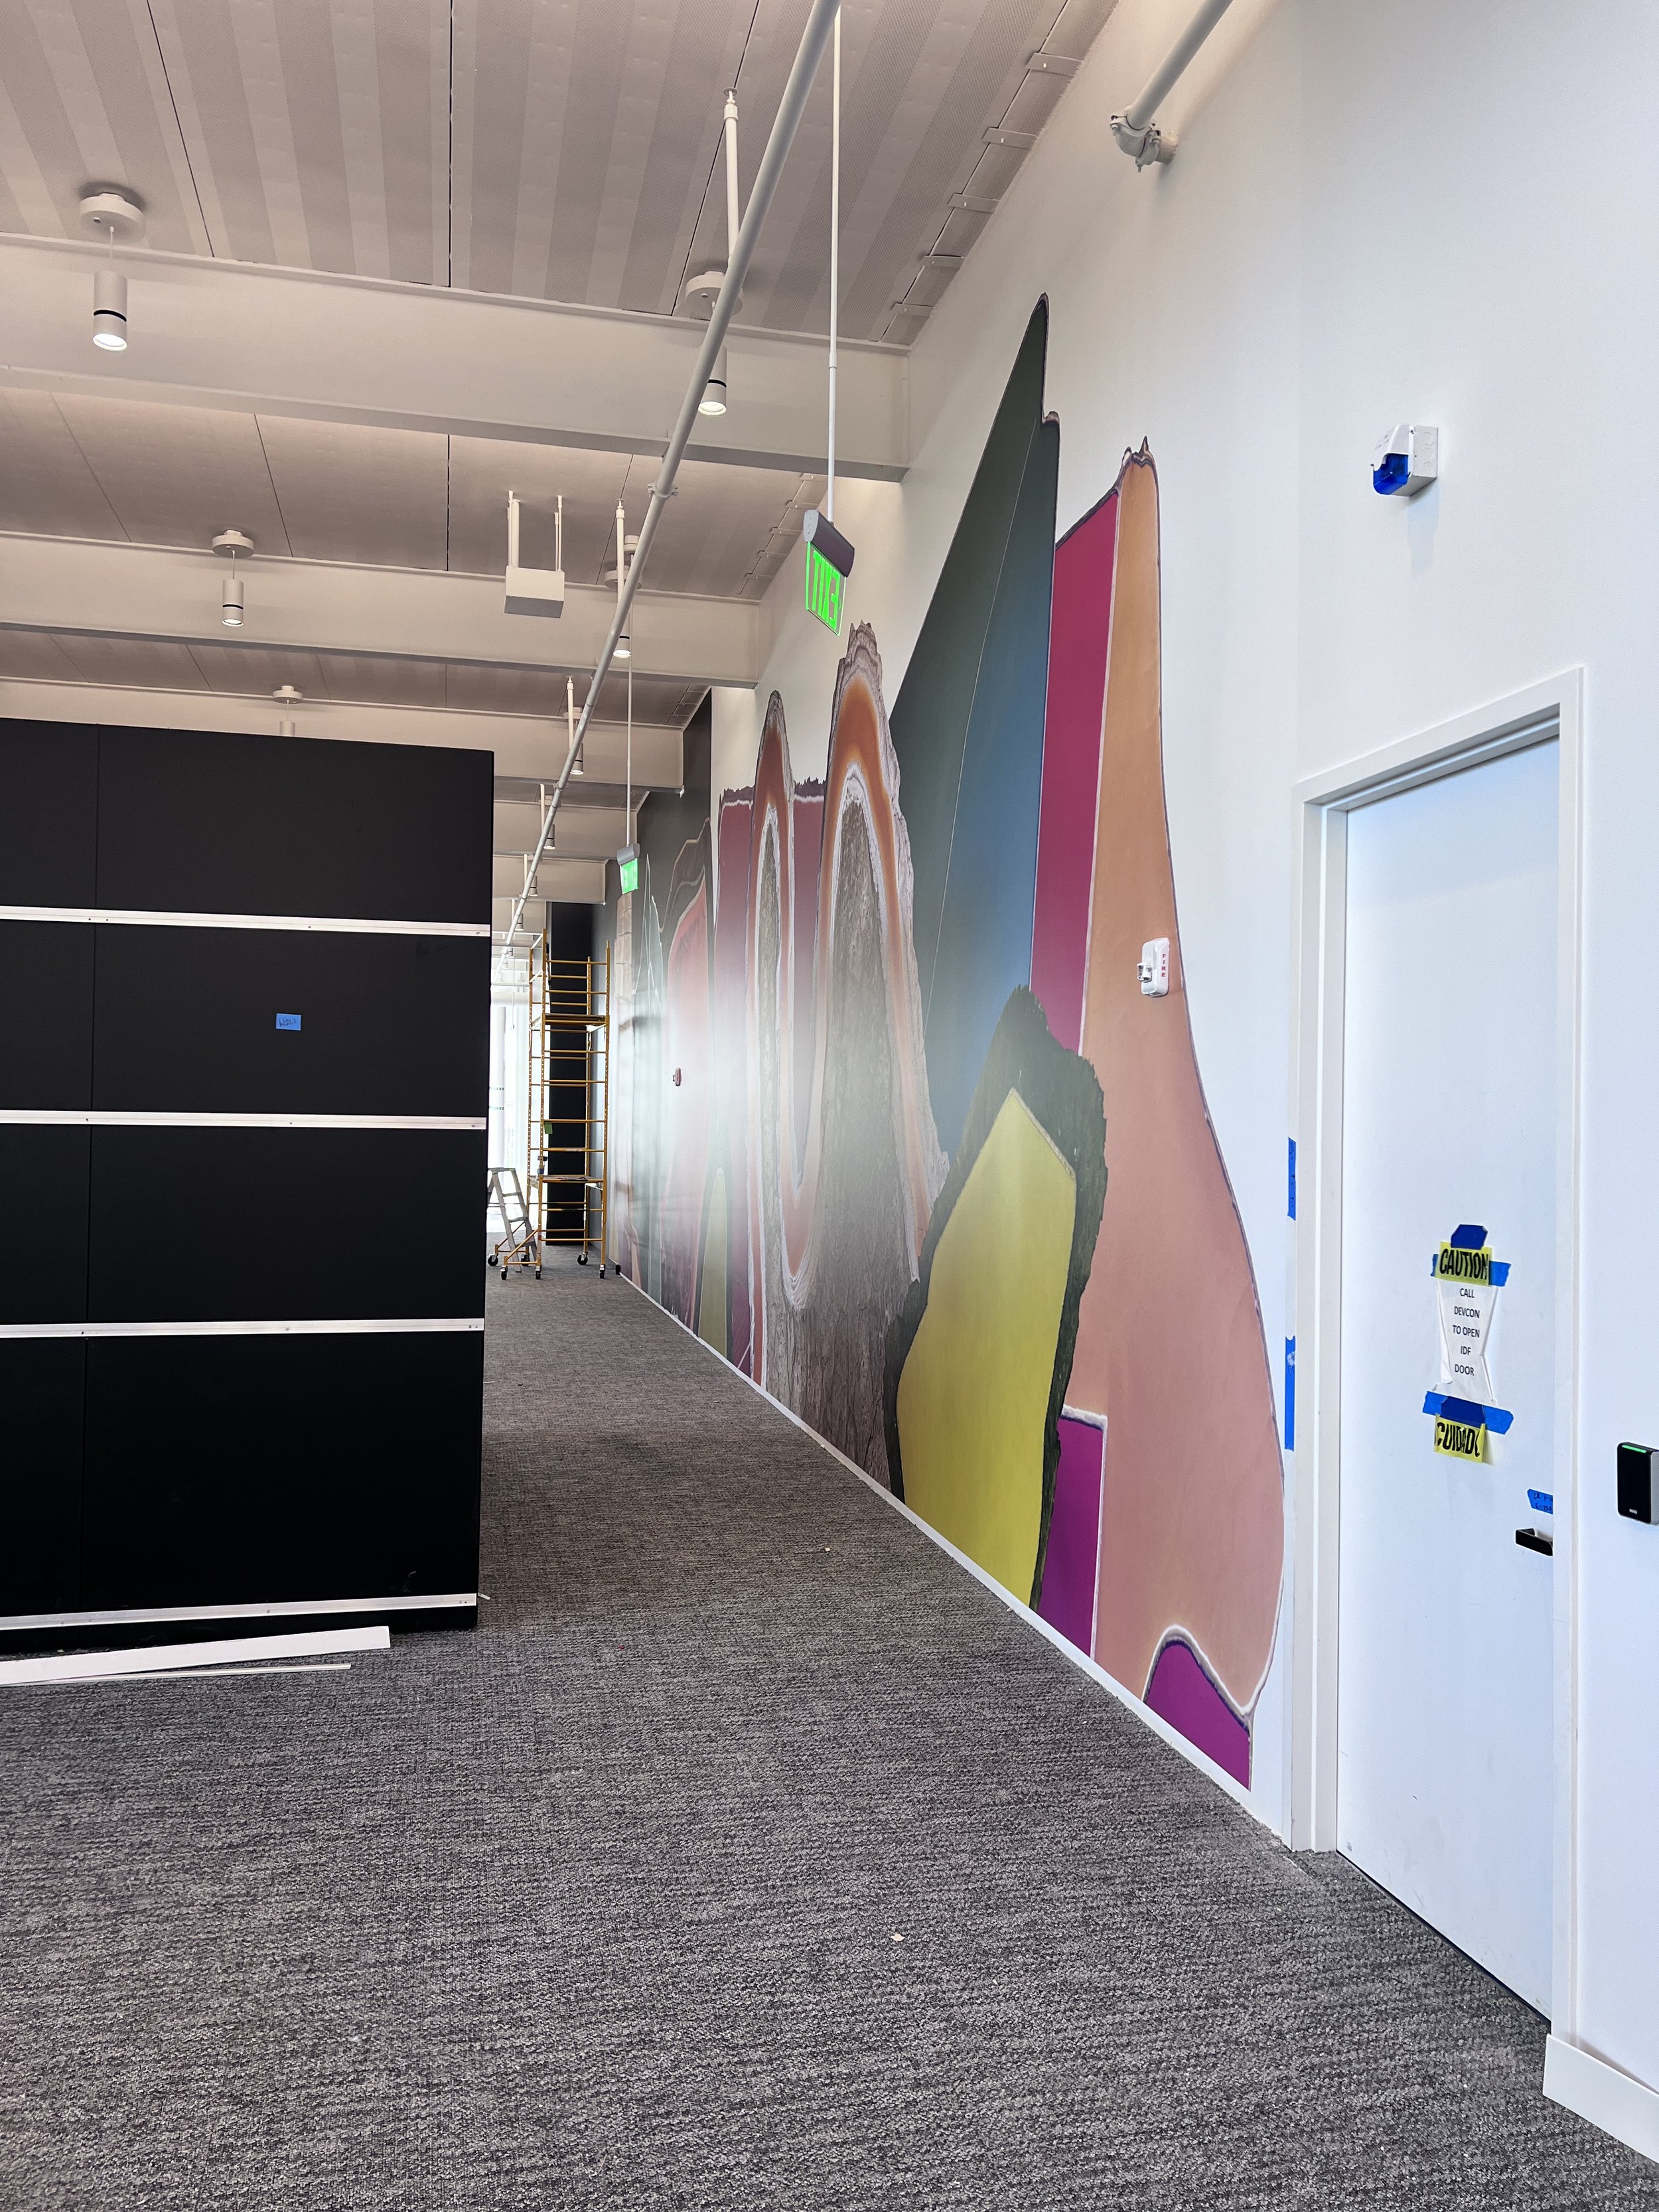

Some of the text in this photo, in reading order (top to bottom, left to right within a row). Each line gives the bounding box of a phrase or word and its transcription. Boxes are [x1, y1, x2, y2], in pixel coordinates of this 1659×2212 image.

[1439, 1248, 1488, 1280] CAUTION
[1460, 1288, 1475, 1298] CALL
[1454, 1305, 1480, 1319] DEVCON
[1452, 1325, 1480, 1338] TO OPEN
[1461, 1345, 1471, 1355] IDF
[1454, 1364, 1475, 1376] DOOR
